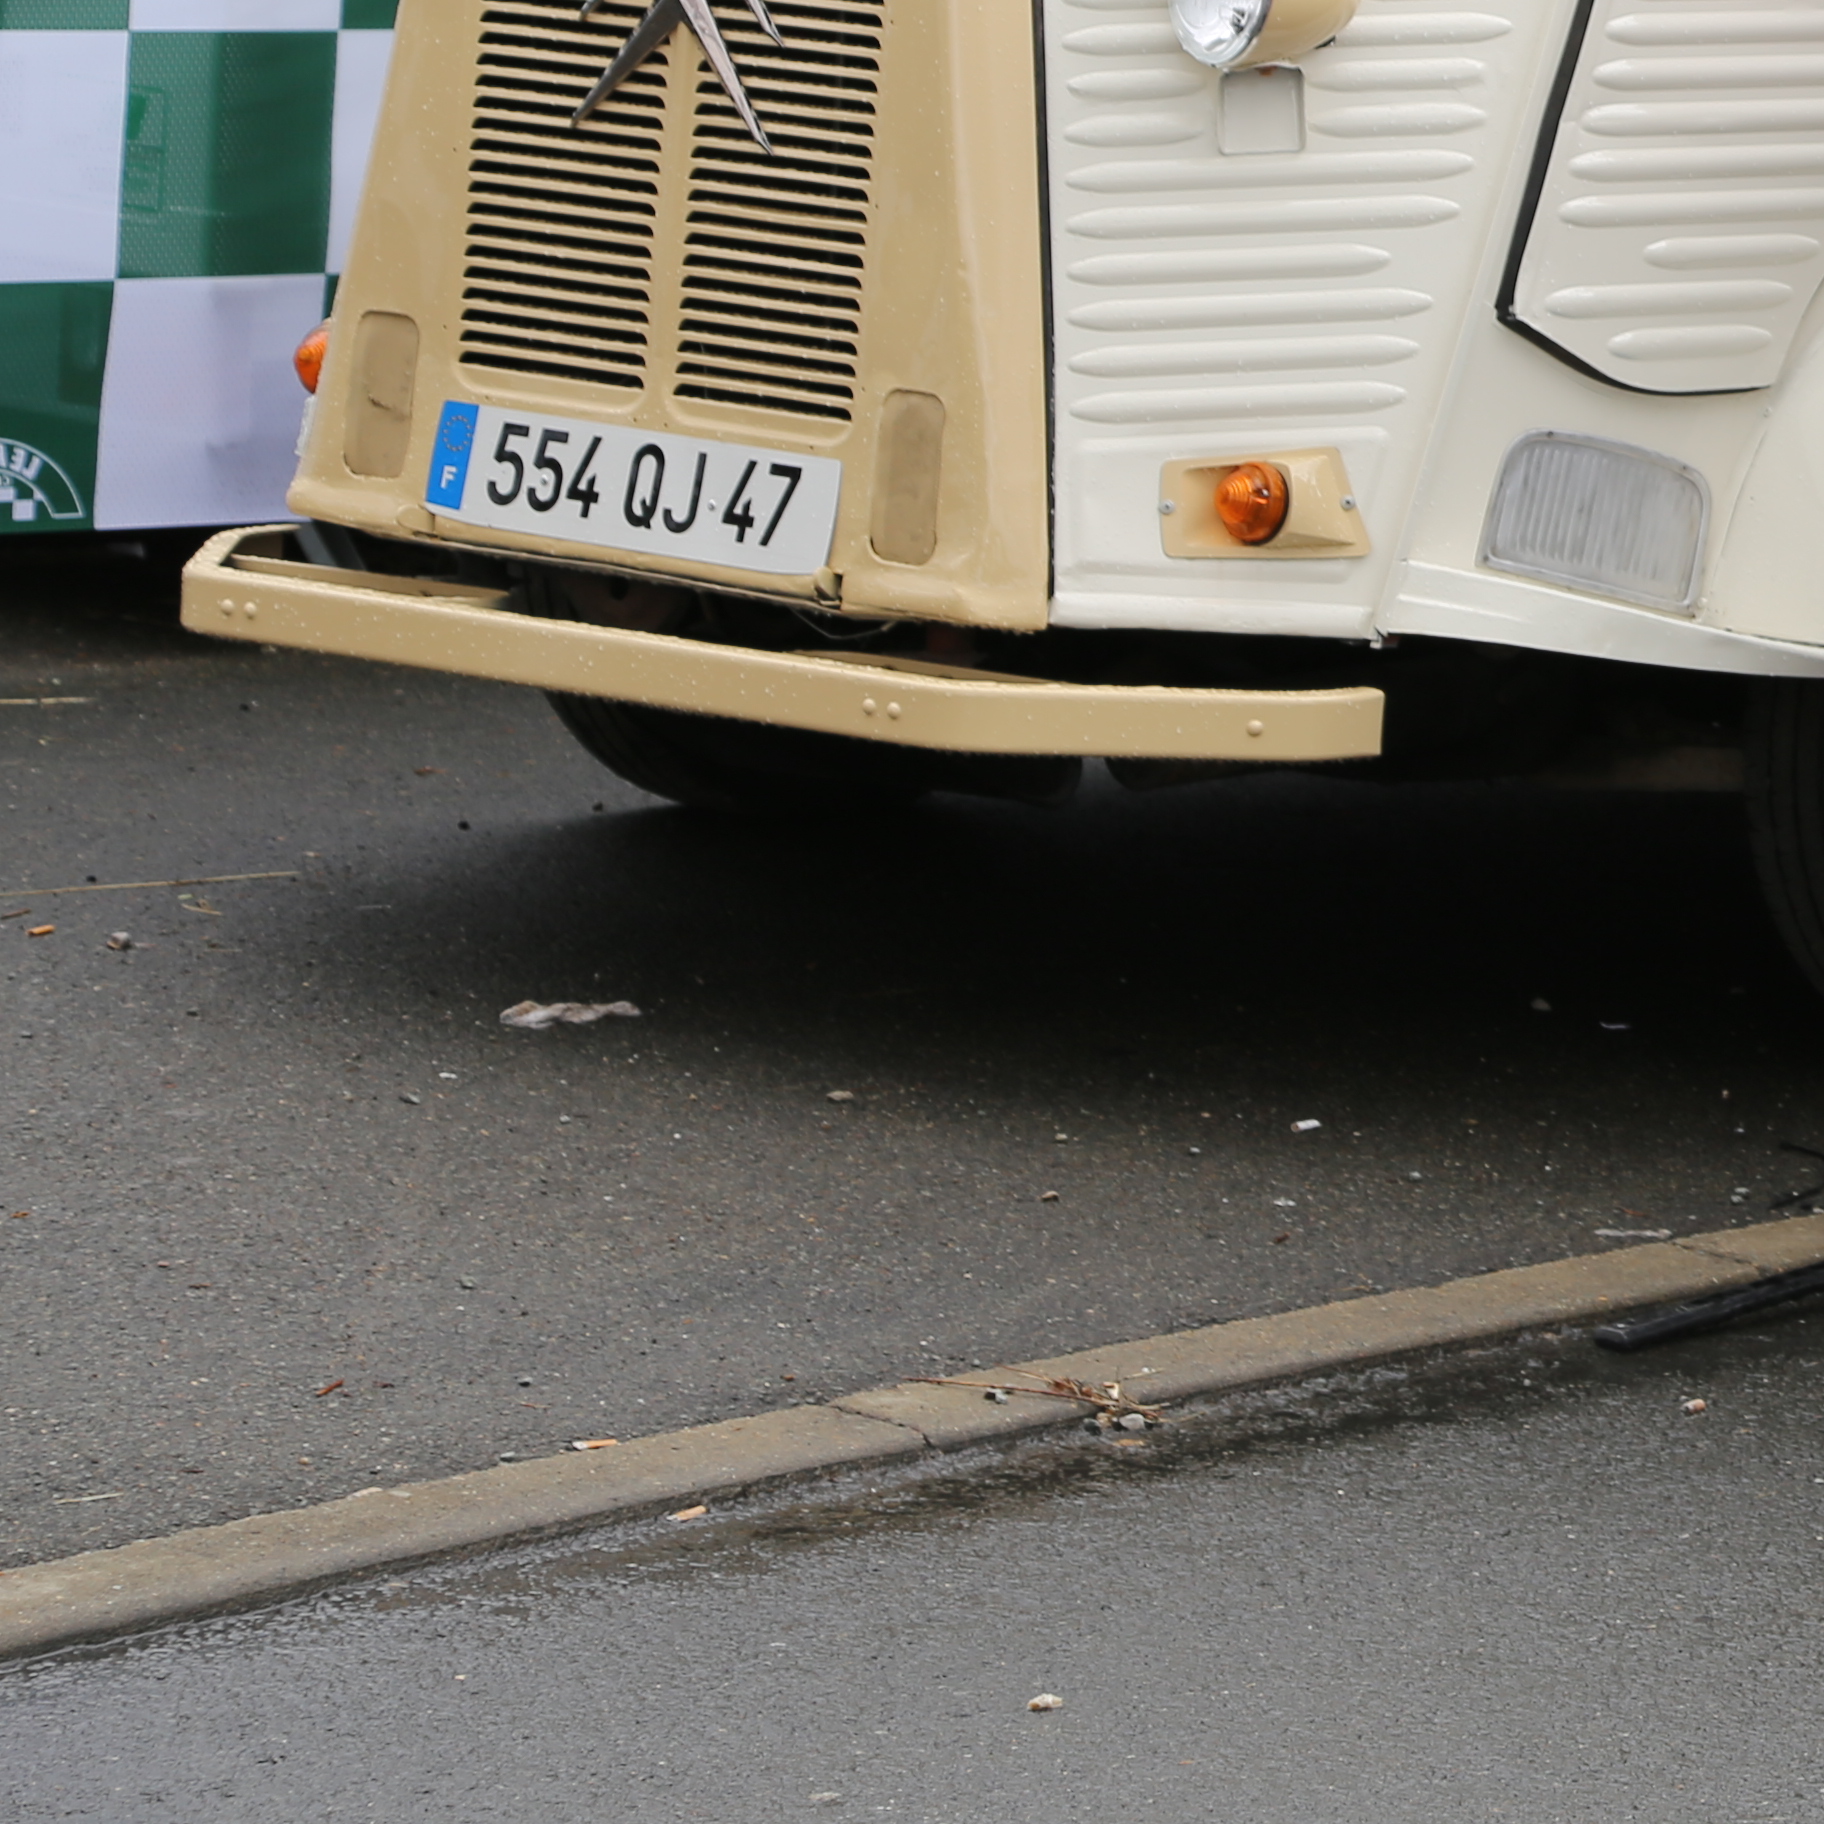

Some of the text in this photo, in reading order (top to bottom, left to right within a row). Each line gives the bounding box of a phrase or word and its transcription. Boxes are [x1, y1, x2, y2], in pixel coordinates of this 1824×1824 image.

[440, 465, 457, 489] F
[486, 422, 802, 547] 554 QJ 47
